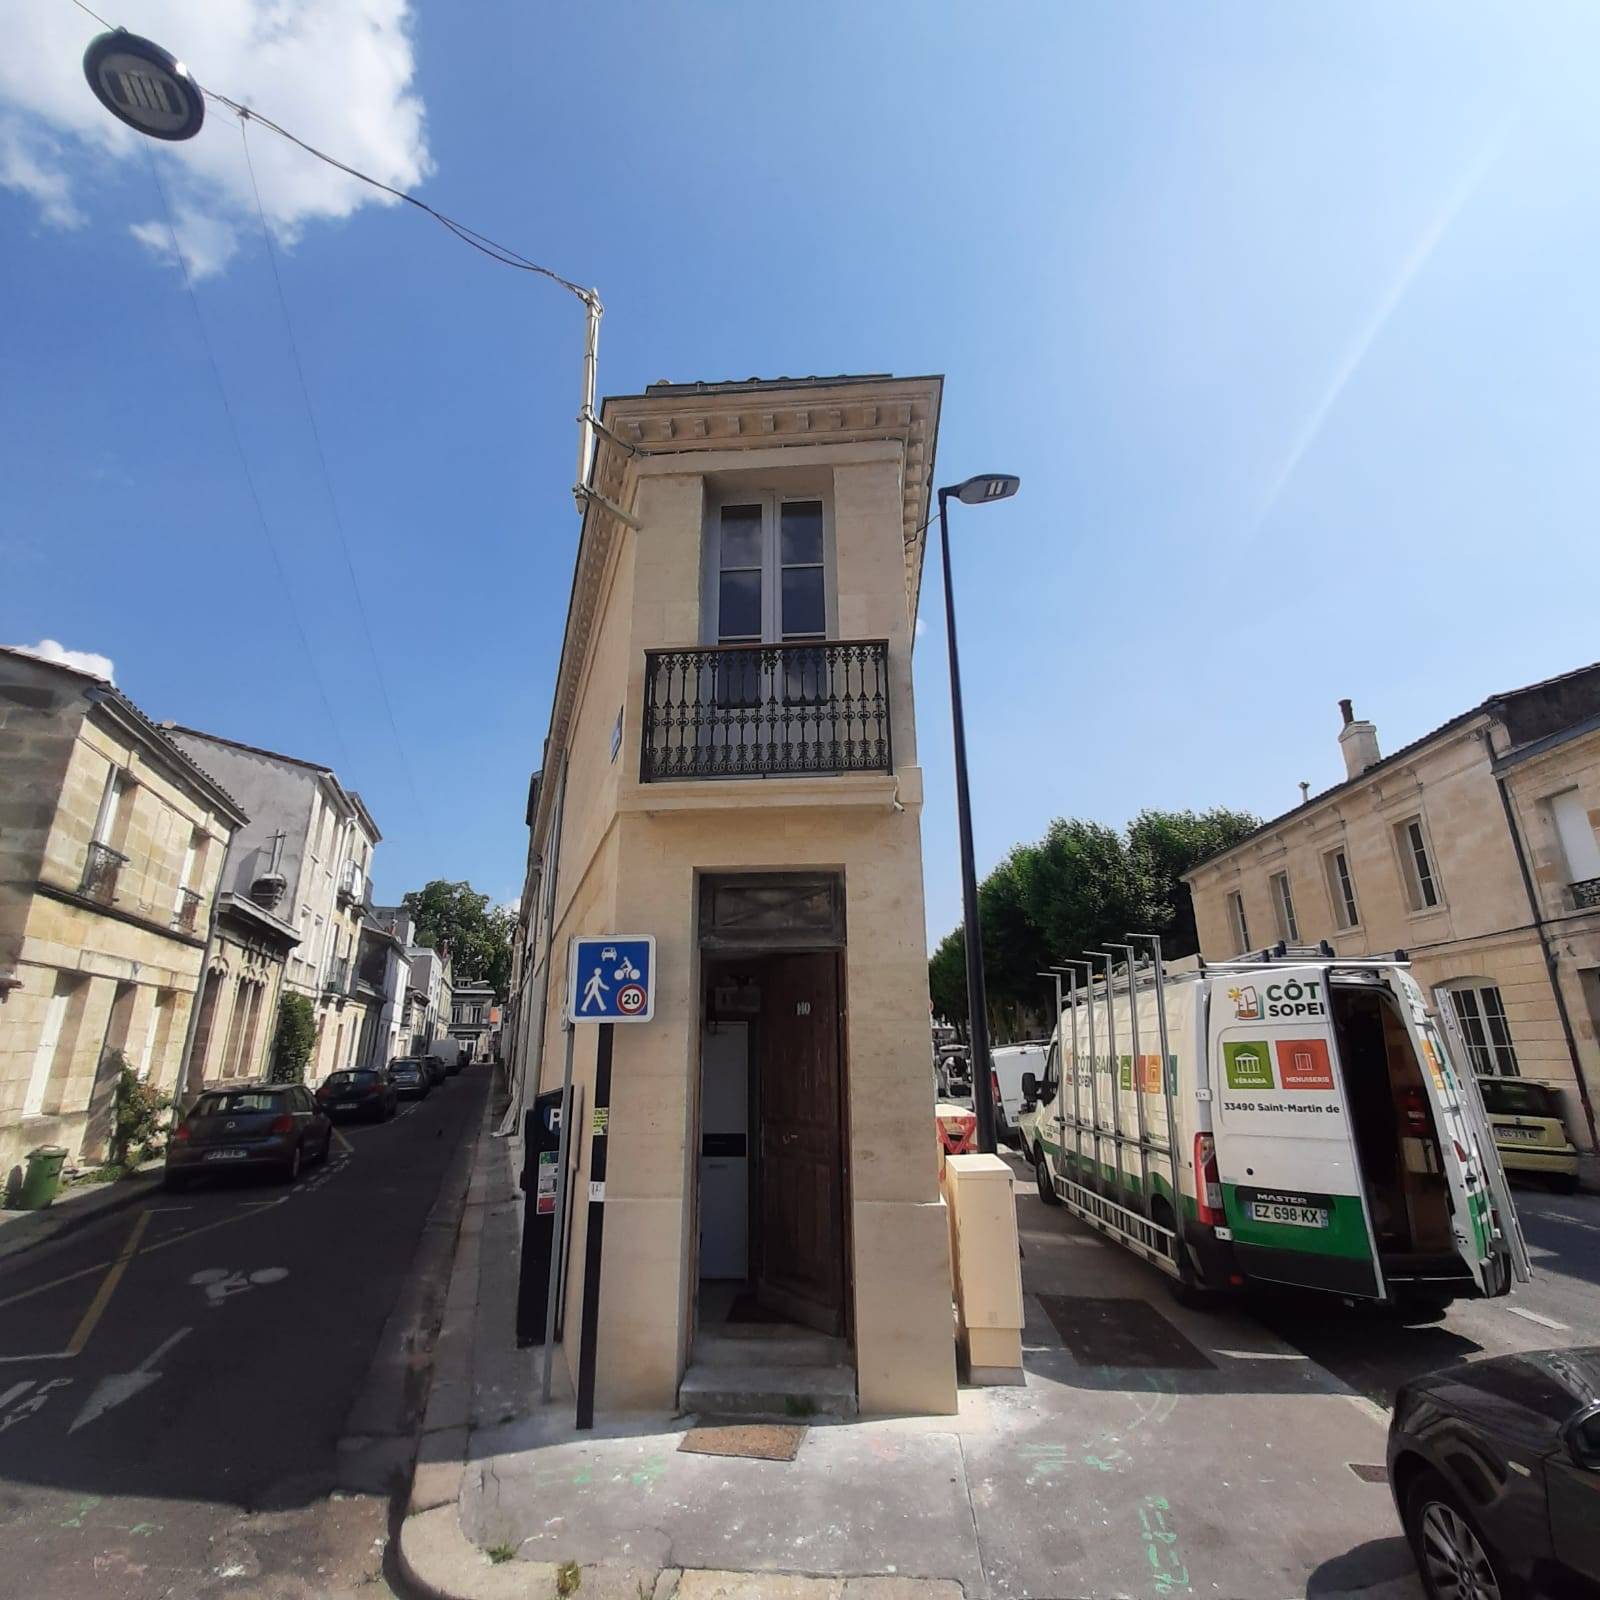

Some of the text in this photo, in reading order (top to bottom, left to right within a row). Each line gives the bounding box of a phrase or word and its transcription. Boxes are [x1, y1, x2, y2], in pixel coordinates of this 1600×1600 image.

[623, 993, 640, 1005] 20
[1224, 1102, 1340, 1113] 33490 Saint-Martin de
[1256, 1193, 1308, 1205] MASTER
